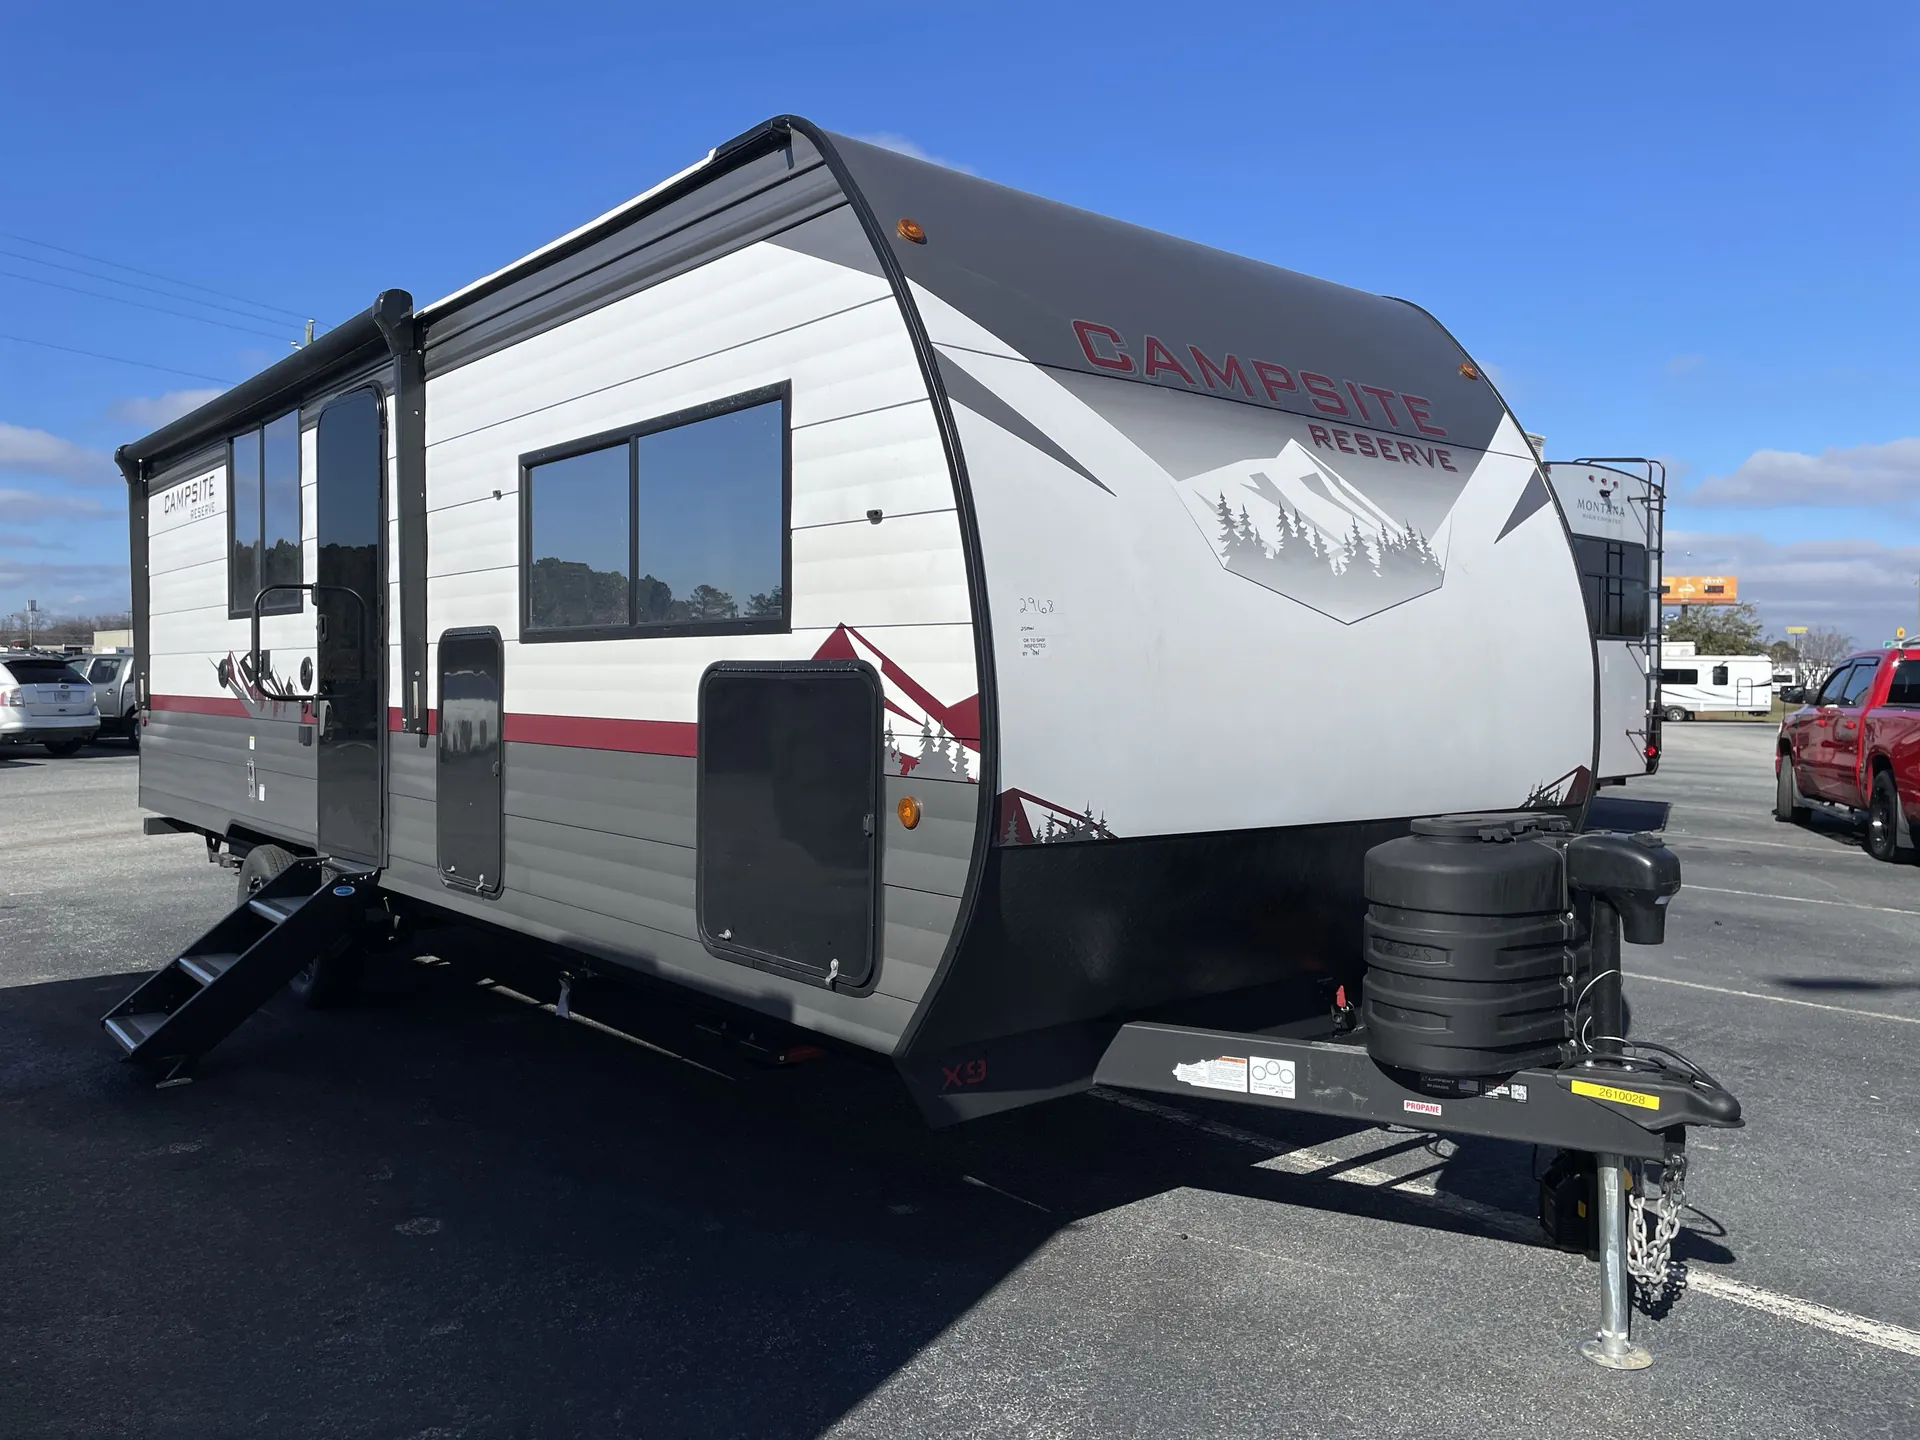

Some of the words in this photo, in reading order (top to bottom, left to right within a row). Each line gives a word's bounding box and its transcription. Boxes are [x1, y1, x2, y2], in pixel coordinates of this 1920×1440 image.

[1071, 319, 1448, 437] CAMPSITE
[1308, 423, 1458, 473] RESERVE
[164, 475, 215, 514] CAMPSITE
[190, 501, 215, 519] RESERVE
[1577, 499, 1625, 517] MONTANA
[1020, 597, 1054, 614] 2968
[1599, 1087, 1646, 1105] 2610028
[1406, 1101, 1440, 1114] PROPANE
